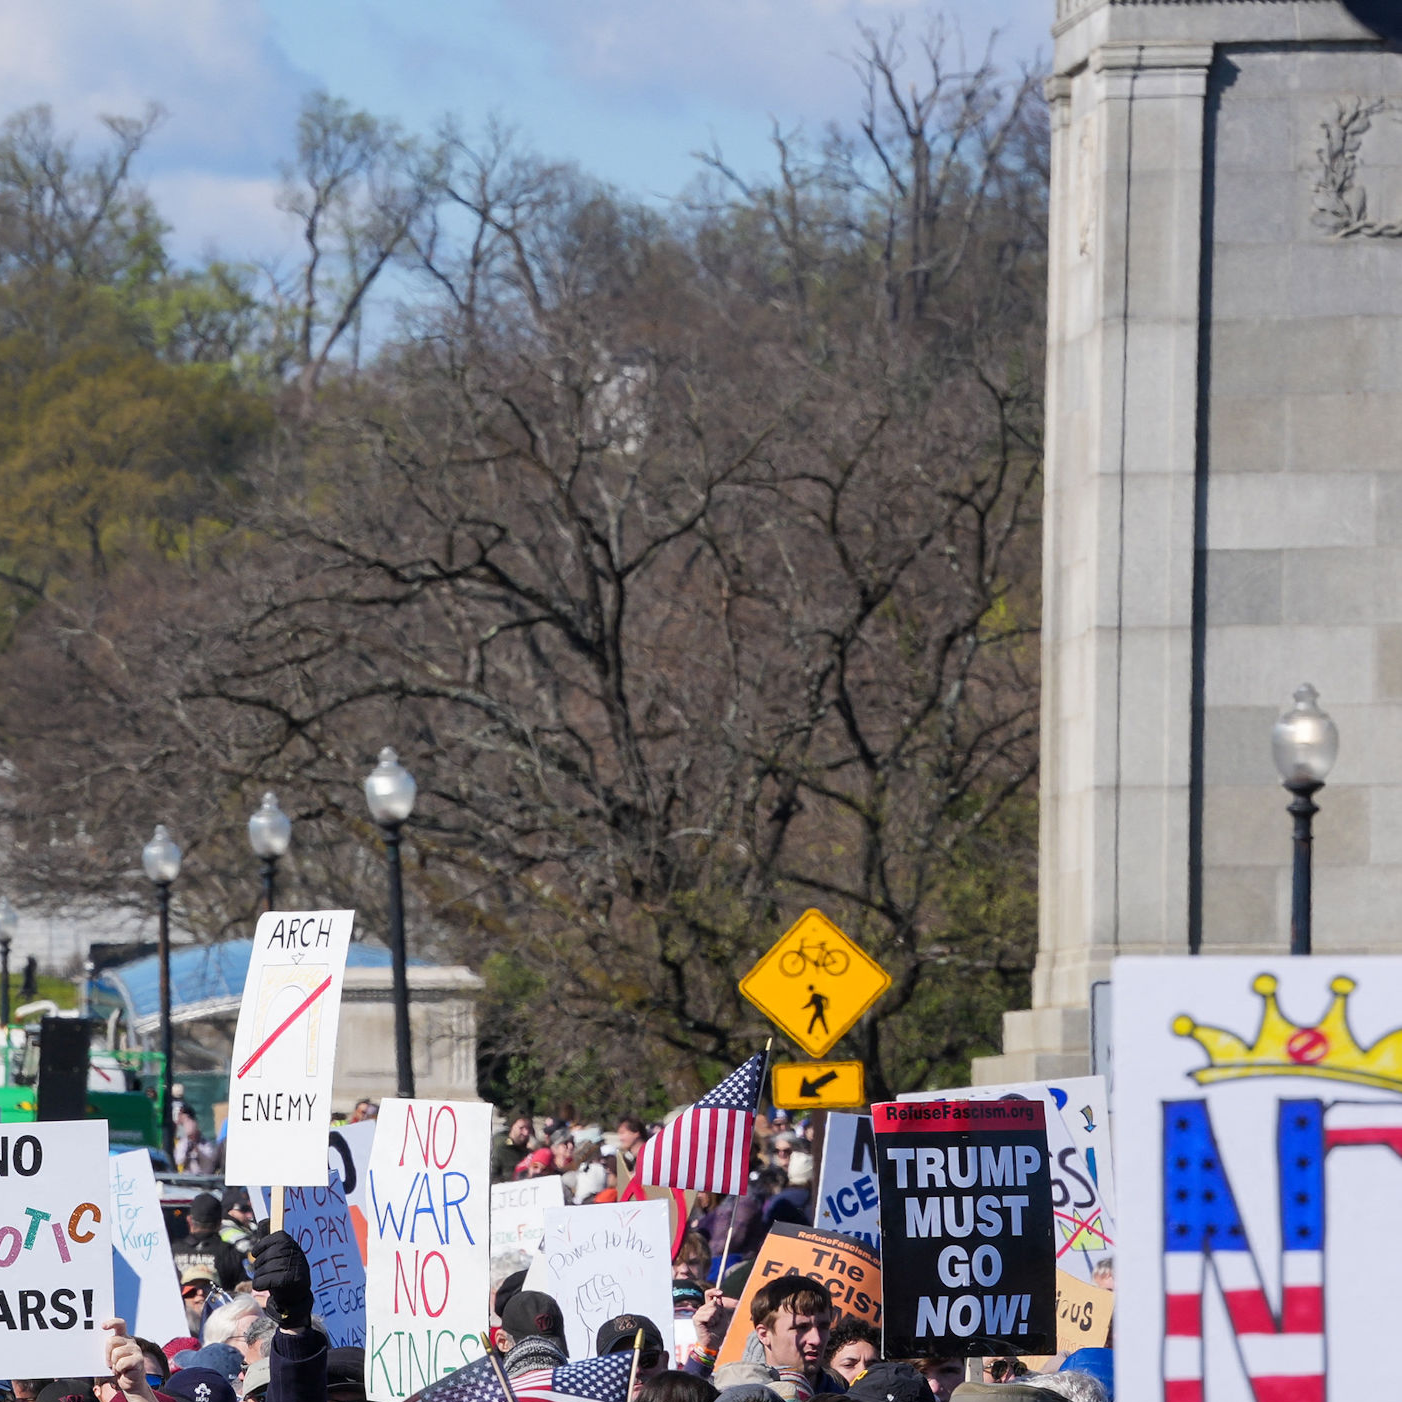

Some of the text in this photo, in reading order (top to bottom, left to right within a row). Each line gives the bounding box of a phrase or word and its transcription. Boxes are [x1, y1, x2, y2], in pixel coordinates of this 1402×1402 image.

[267, 917, 333, 950] ARCH
[242, 1093, 317, 1123] ENEMY
[886, 1104, 1034, 1121] RefuseFascism.org
[399, 1104, 458, 1169] NO
[886, 1145, 1041, 1189] TRUMP
[116, 1193, 144, 1222] For
[369, 1171, 476, 1246] WAR
[825, 1175, 878, 1225] ICE
[905, 1195, 1030, 1239] MUST
[119, 1221, 160, 1262] Kings
[314, 1213, 349, 1248] PAY
[625, 1226, 654, 1259] the
[312, 1254, 348, 1288] IF
[395, 1249, 451, 1318] NO
[812, 1248, 865, 1283] The
[937, 1244, 1003, 1289] GO
[915, 1294, 1032, 1338] NOW!
